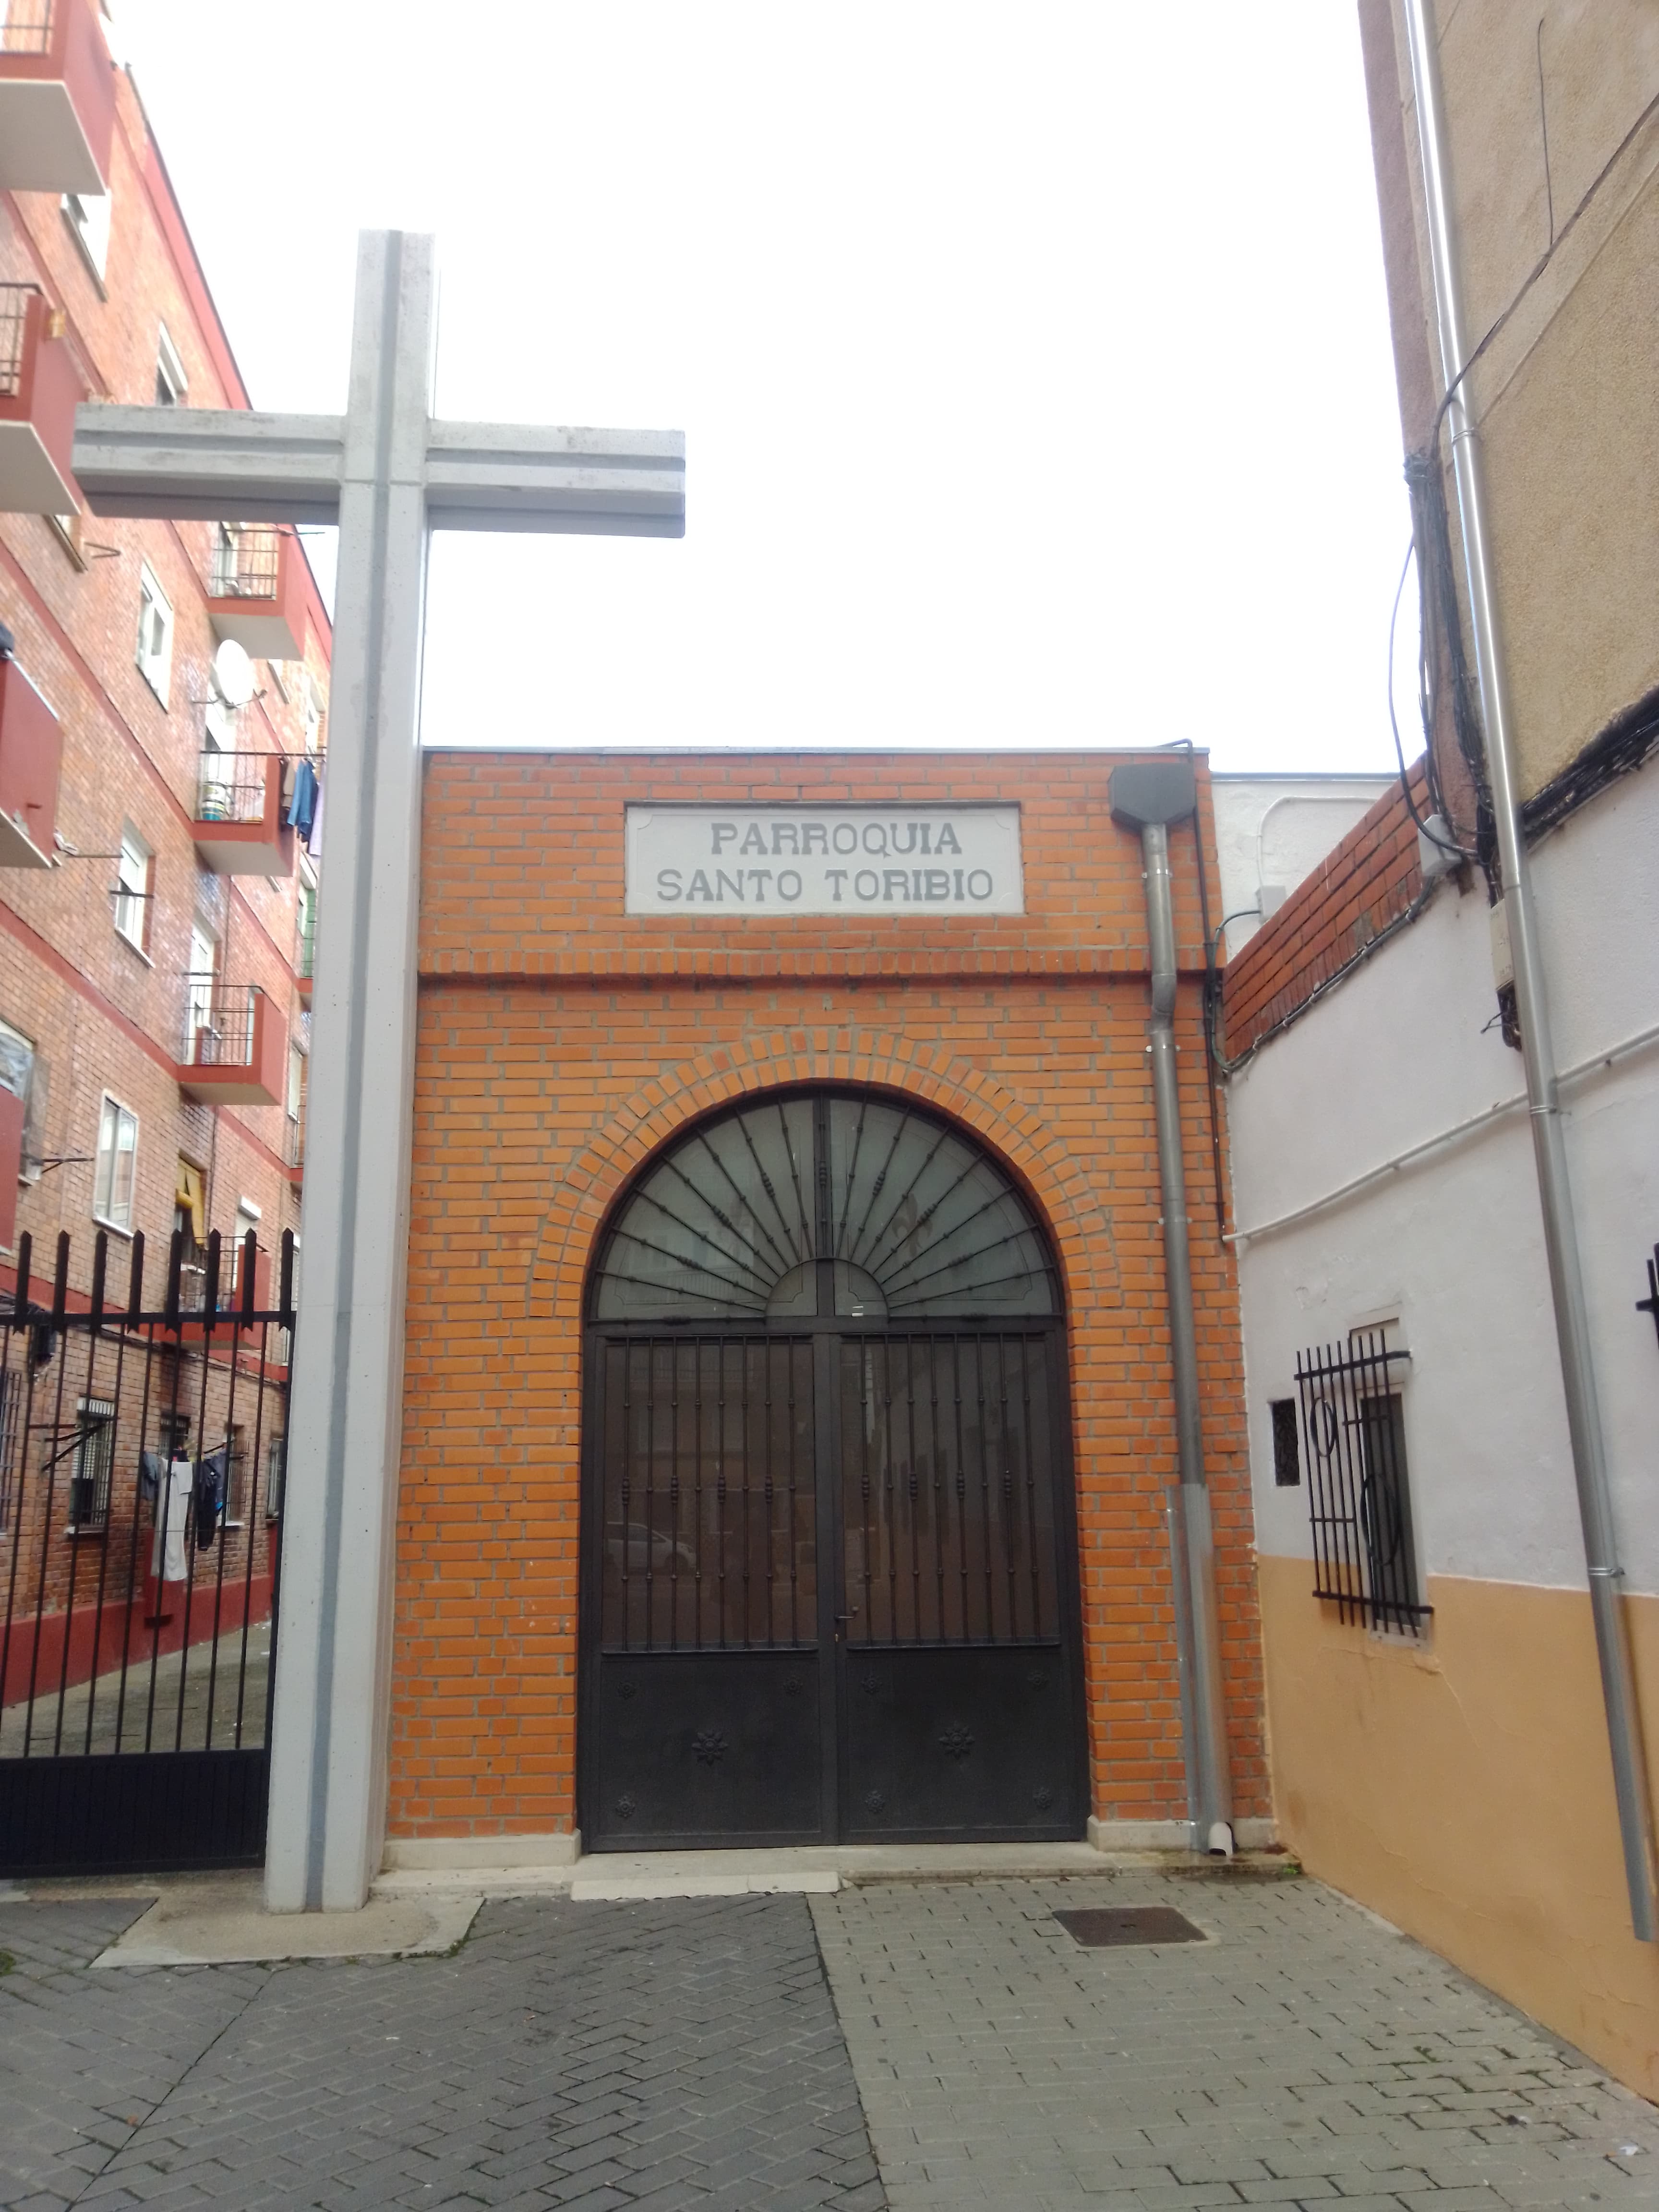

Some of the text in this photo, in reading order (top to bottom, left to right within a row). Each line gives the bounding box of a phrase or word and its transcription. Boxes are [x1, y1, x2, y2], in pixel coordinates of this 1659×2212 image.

[711, 823, 962, 857] PARROQUIA
[657, 869, 992, 901] SANTO TORIBIO
